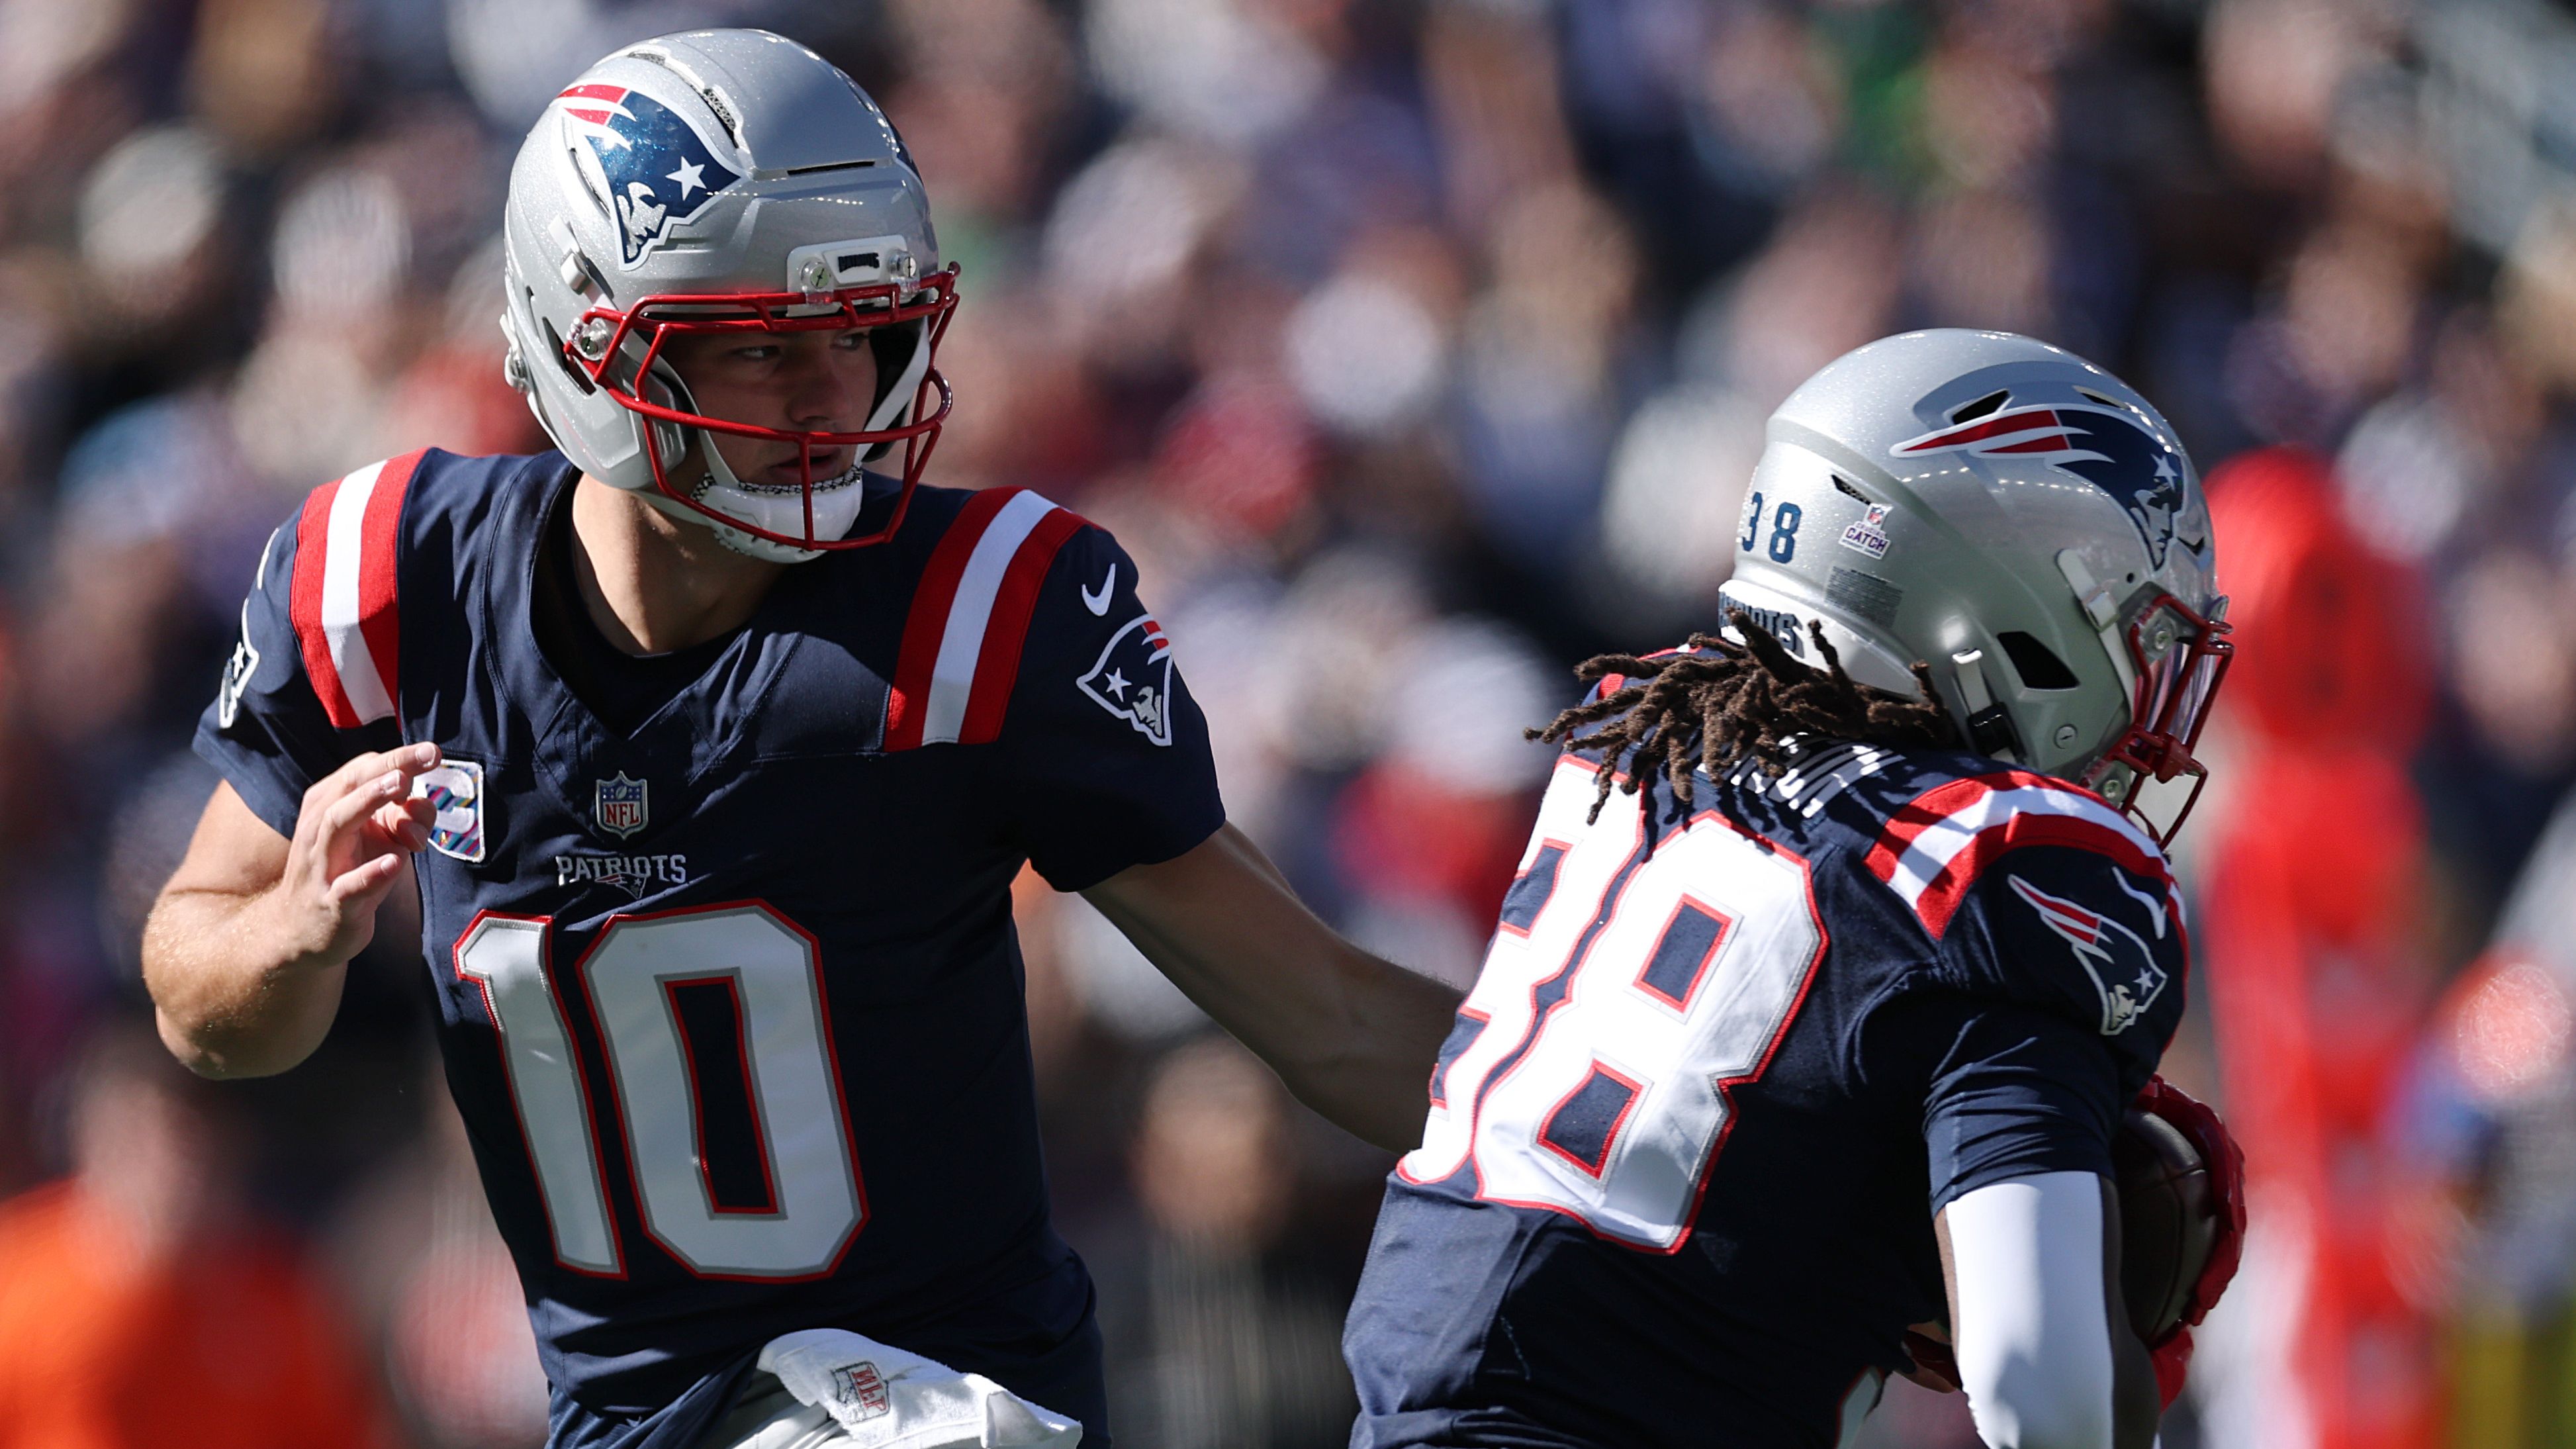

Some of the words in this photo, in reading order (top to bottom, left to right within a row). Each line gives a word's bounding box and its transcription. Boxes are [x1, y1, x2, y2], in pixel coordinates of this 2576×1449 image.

[1845, 527, 1889, 552] CATCH
[605, 803, 639, 827] NFL
[555, 854, 686, 886] PATRIOTS
[1397, 754, 1830, 1255] 38
[453, 898, 870, 1284] 10
